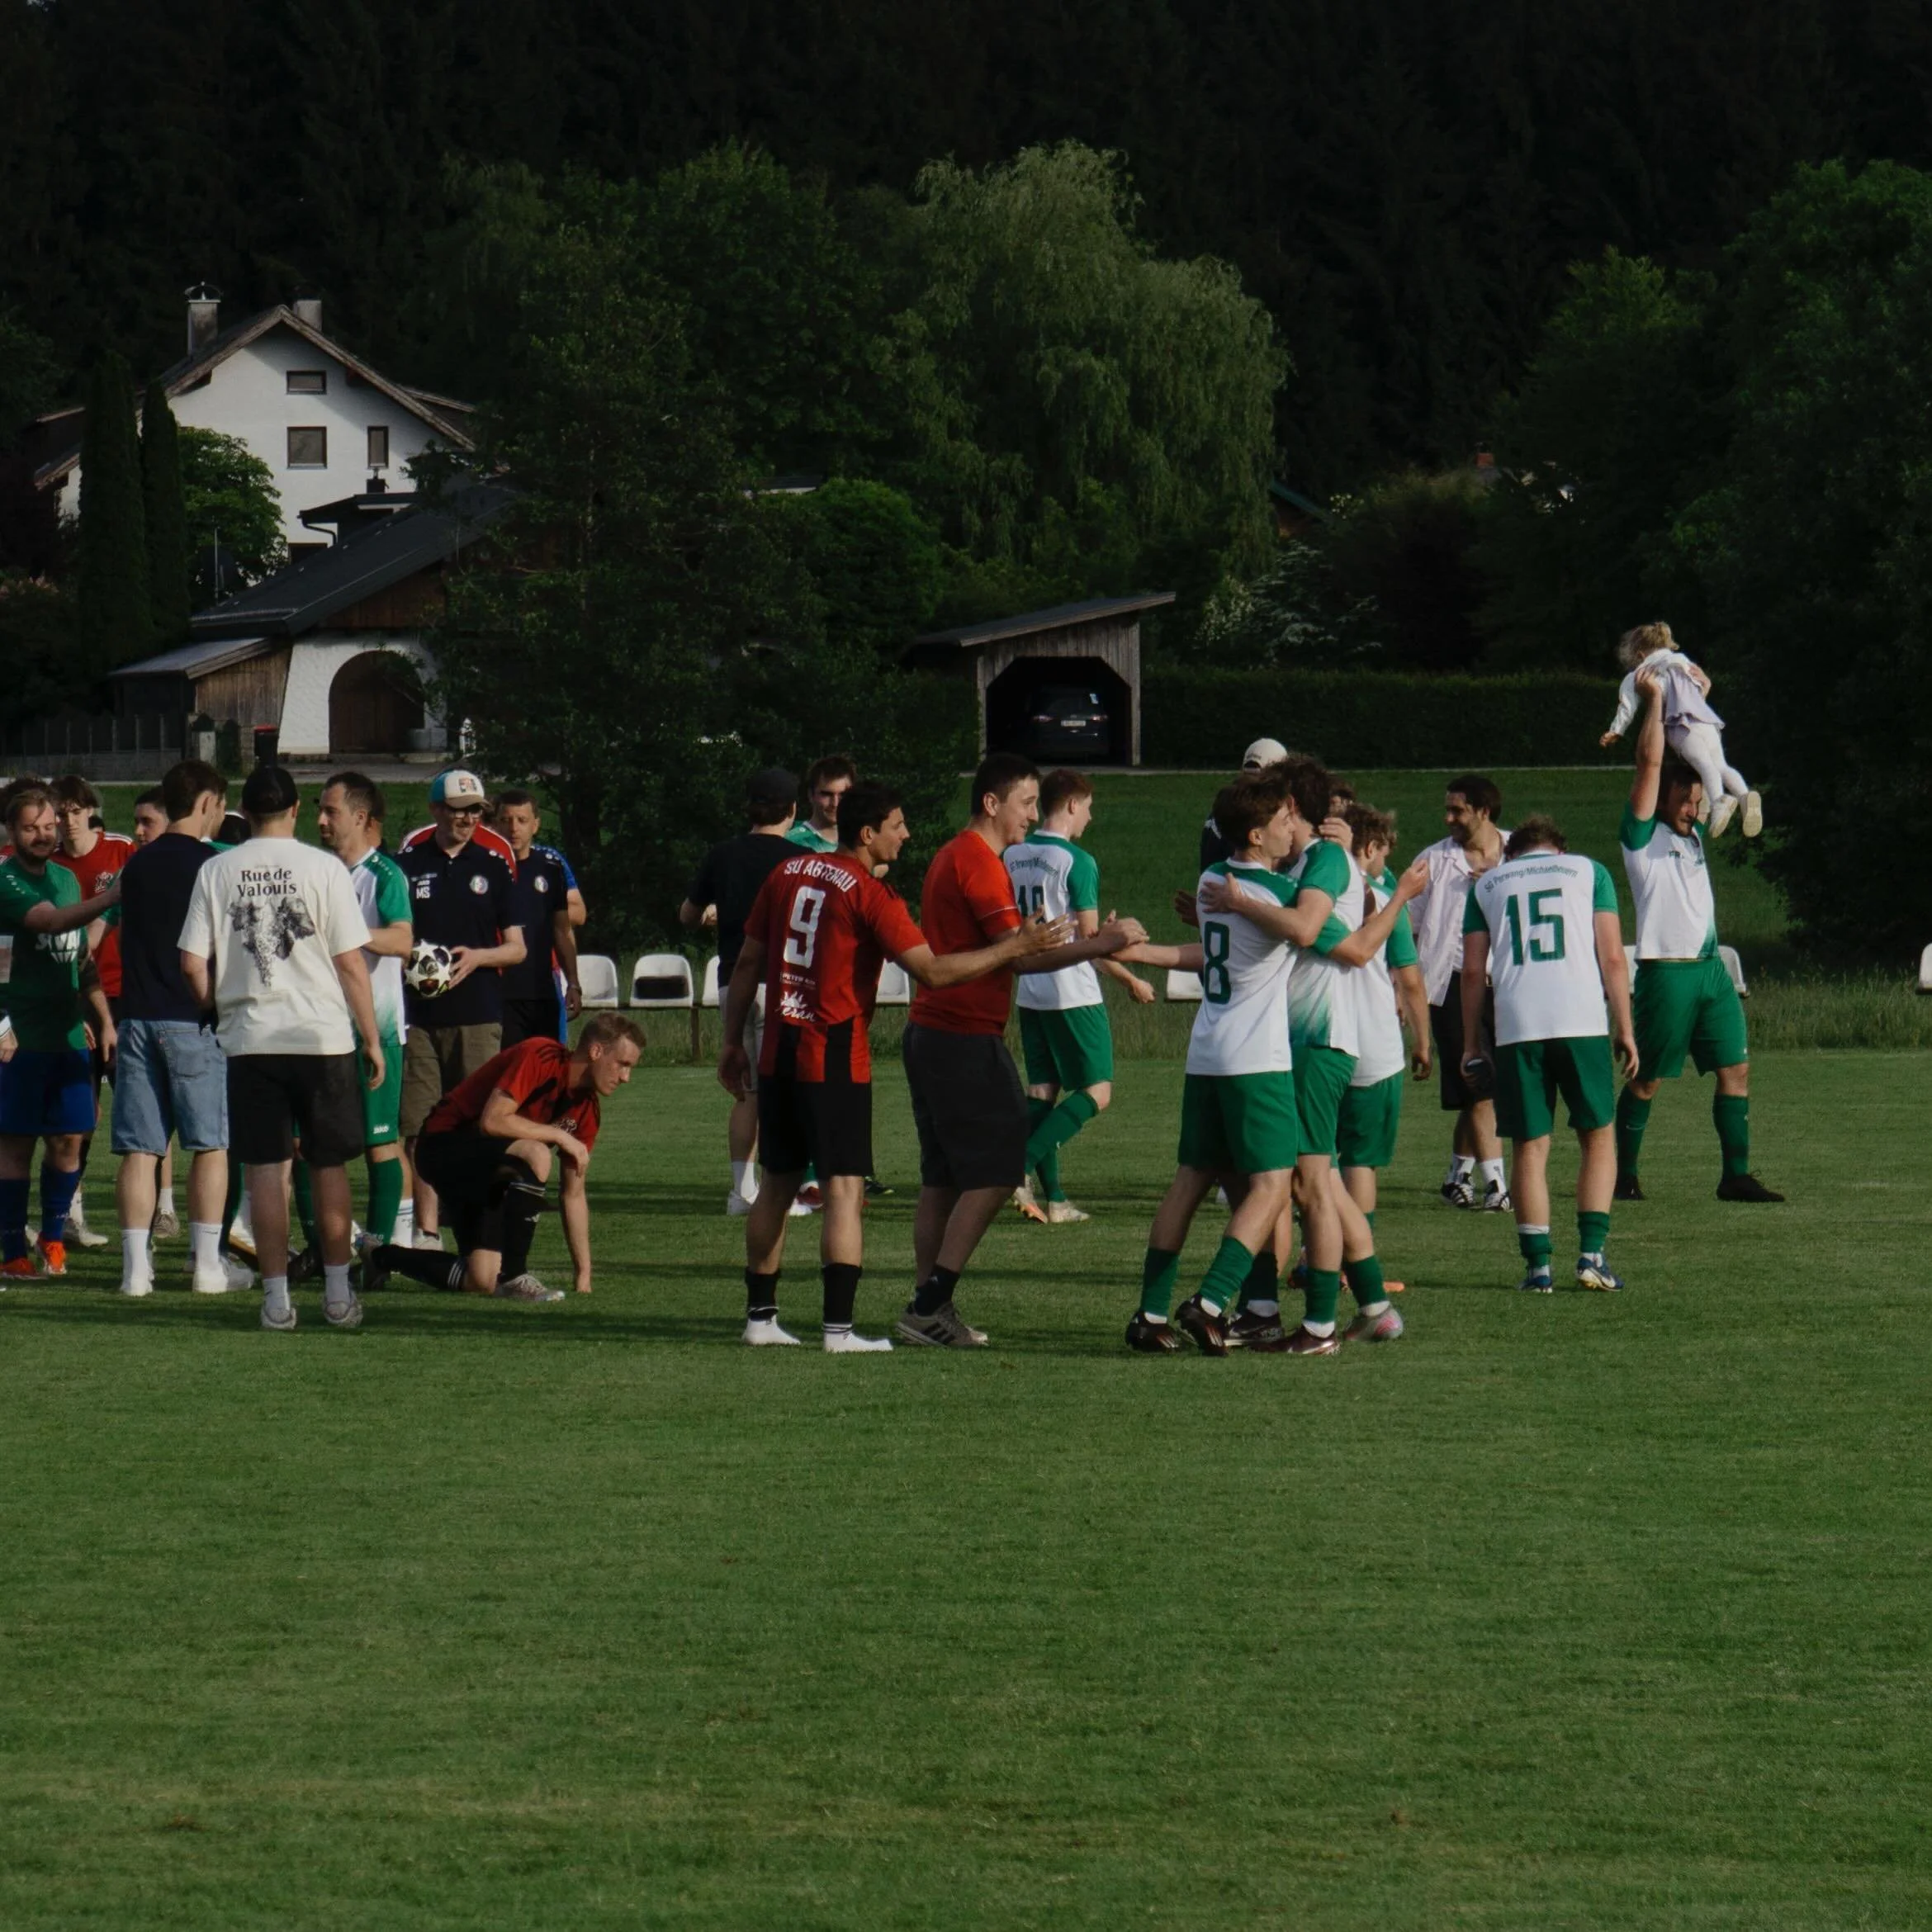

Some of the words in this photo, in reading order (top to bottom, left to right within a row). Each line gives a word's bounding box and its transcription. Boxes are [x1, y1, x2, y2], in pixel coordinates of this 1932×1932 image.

[240, 869, 272, 883] Rue
[273, 868, 292, 881] de
[784, 859, 805, 874] SU
[236, 880, 297, 898] Valouis
[415, 886, 430, 899] MS
[783, 885, 826, 968] 9
[1505, 888, 1565, 967] 15
[1204, 921, 1232, 1005] 8
